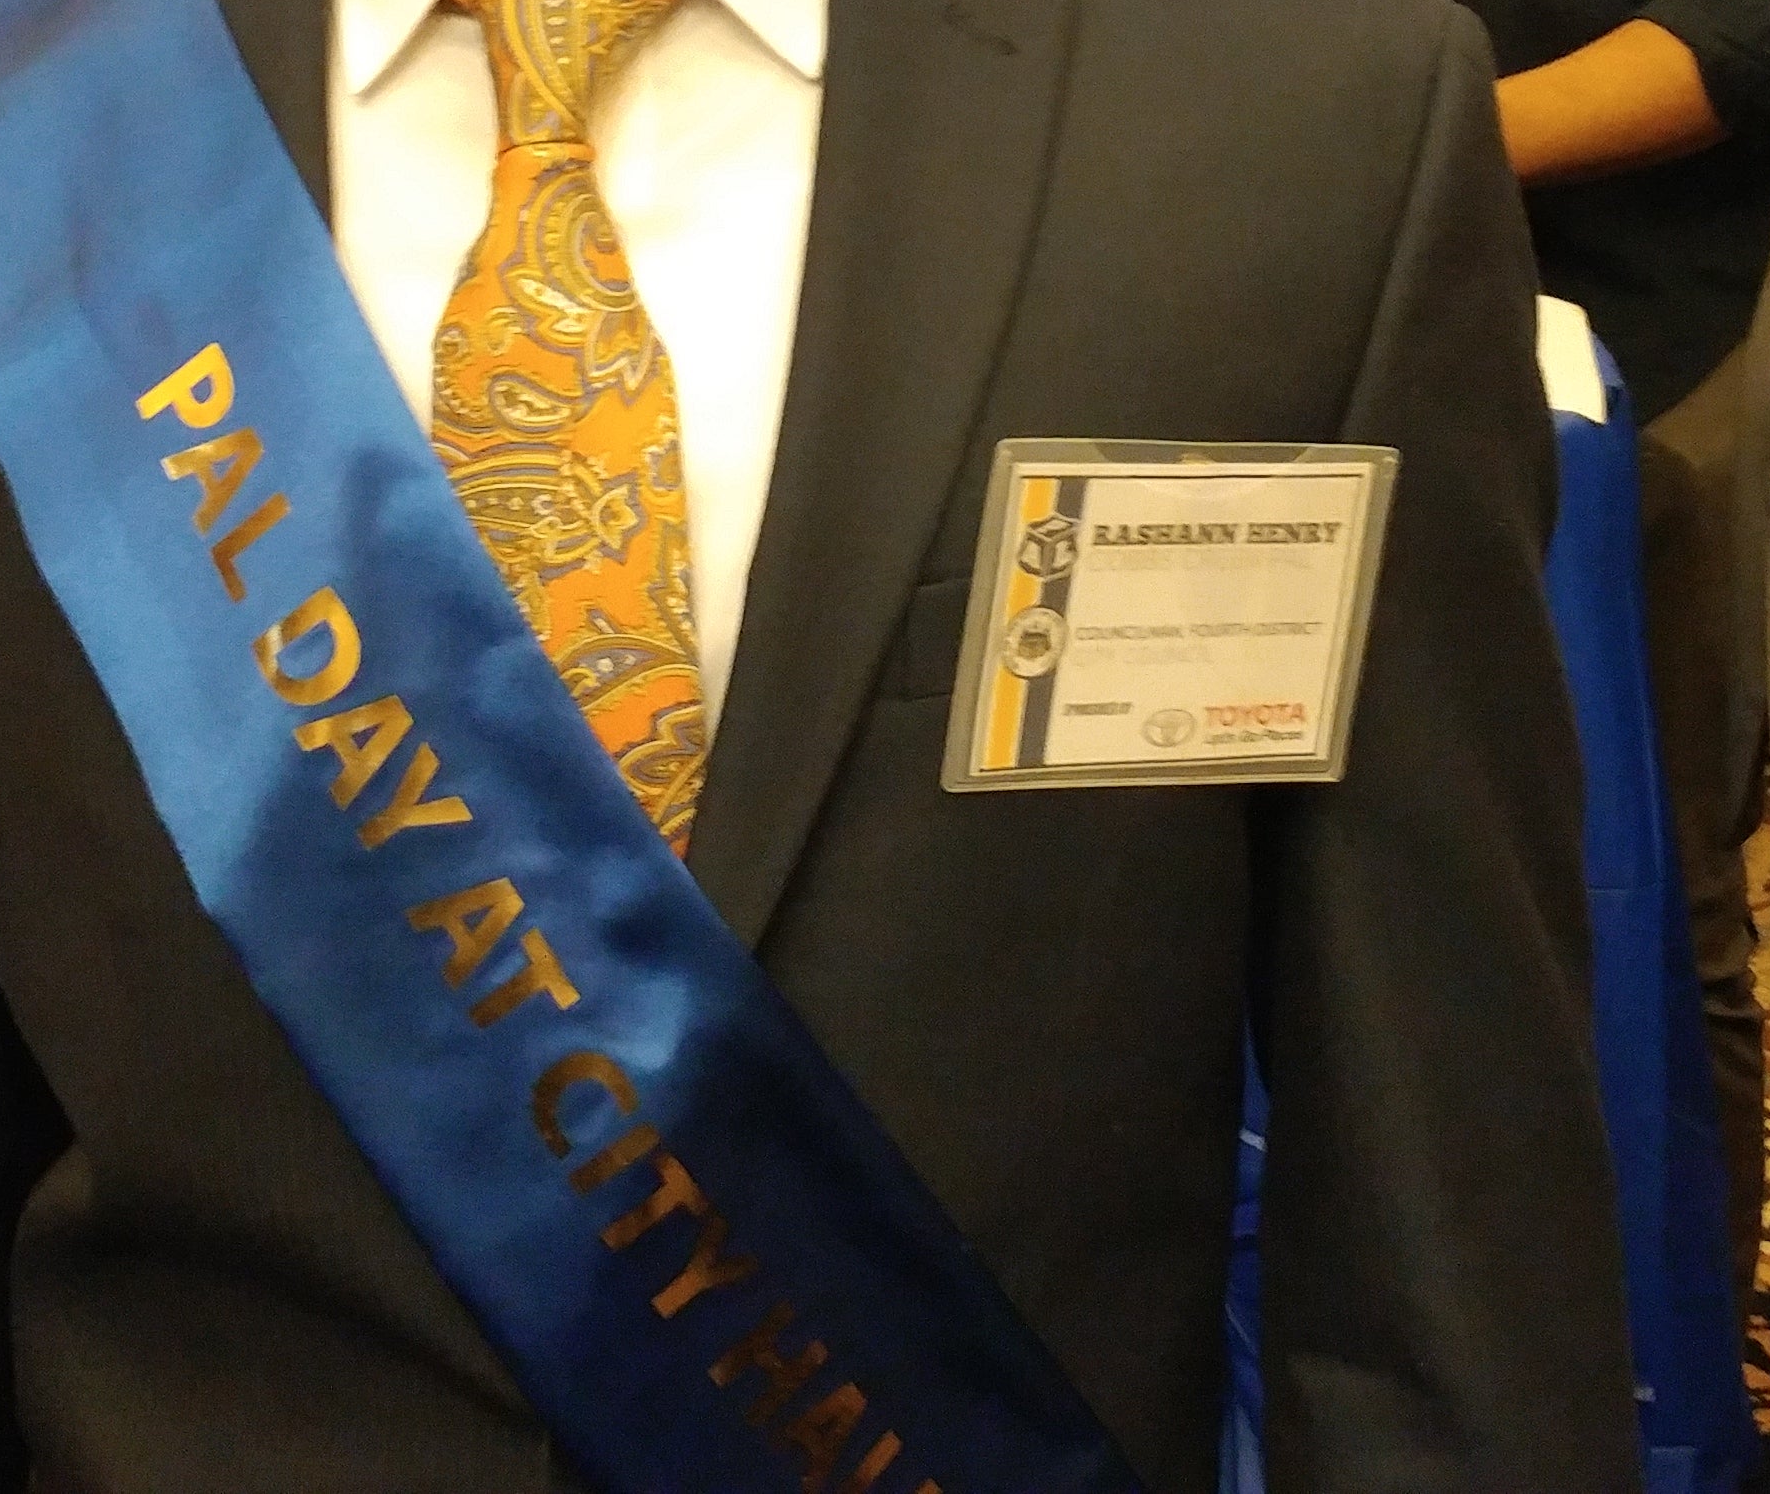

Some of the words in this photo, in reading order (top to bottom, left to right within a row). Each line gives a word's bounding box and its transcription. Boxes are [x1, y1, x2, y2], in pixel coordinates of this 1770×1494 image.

[1092, 522, 1237, 547] RASHANN
[1245, 521, 1342, 544] HENRY
[1205, 703, 1306, 727] TOYOTA
[136, 342, 292, 603] PAL
[250, 585, 474, 851] DAY
[404, 877, 581, 1029] AT
[532, 1050, 761, 1319] CITY
